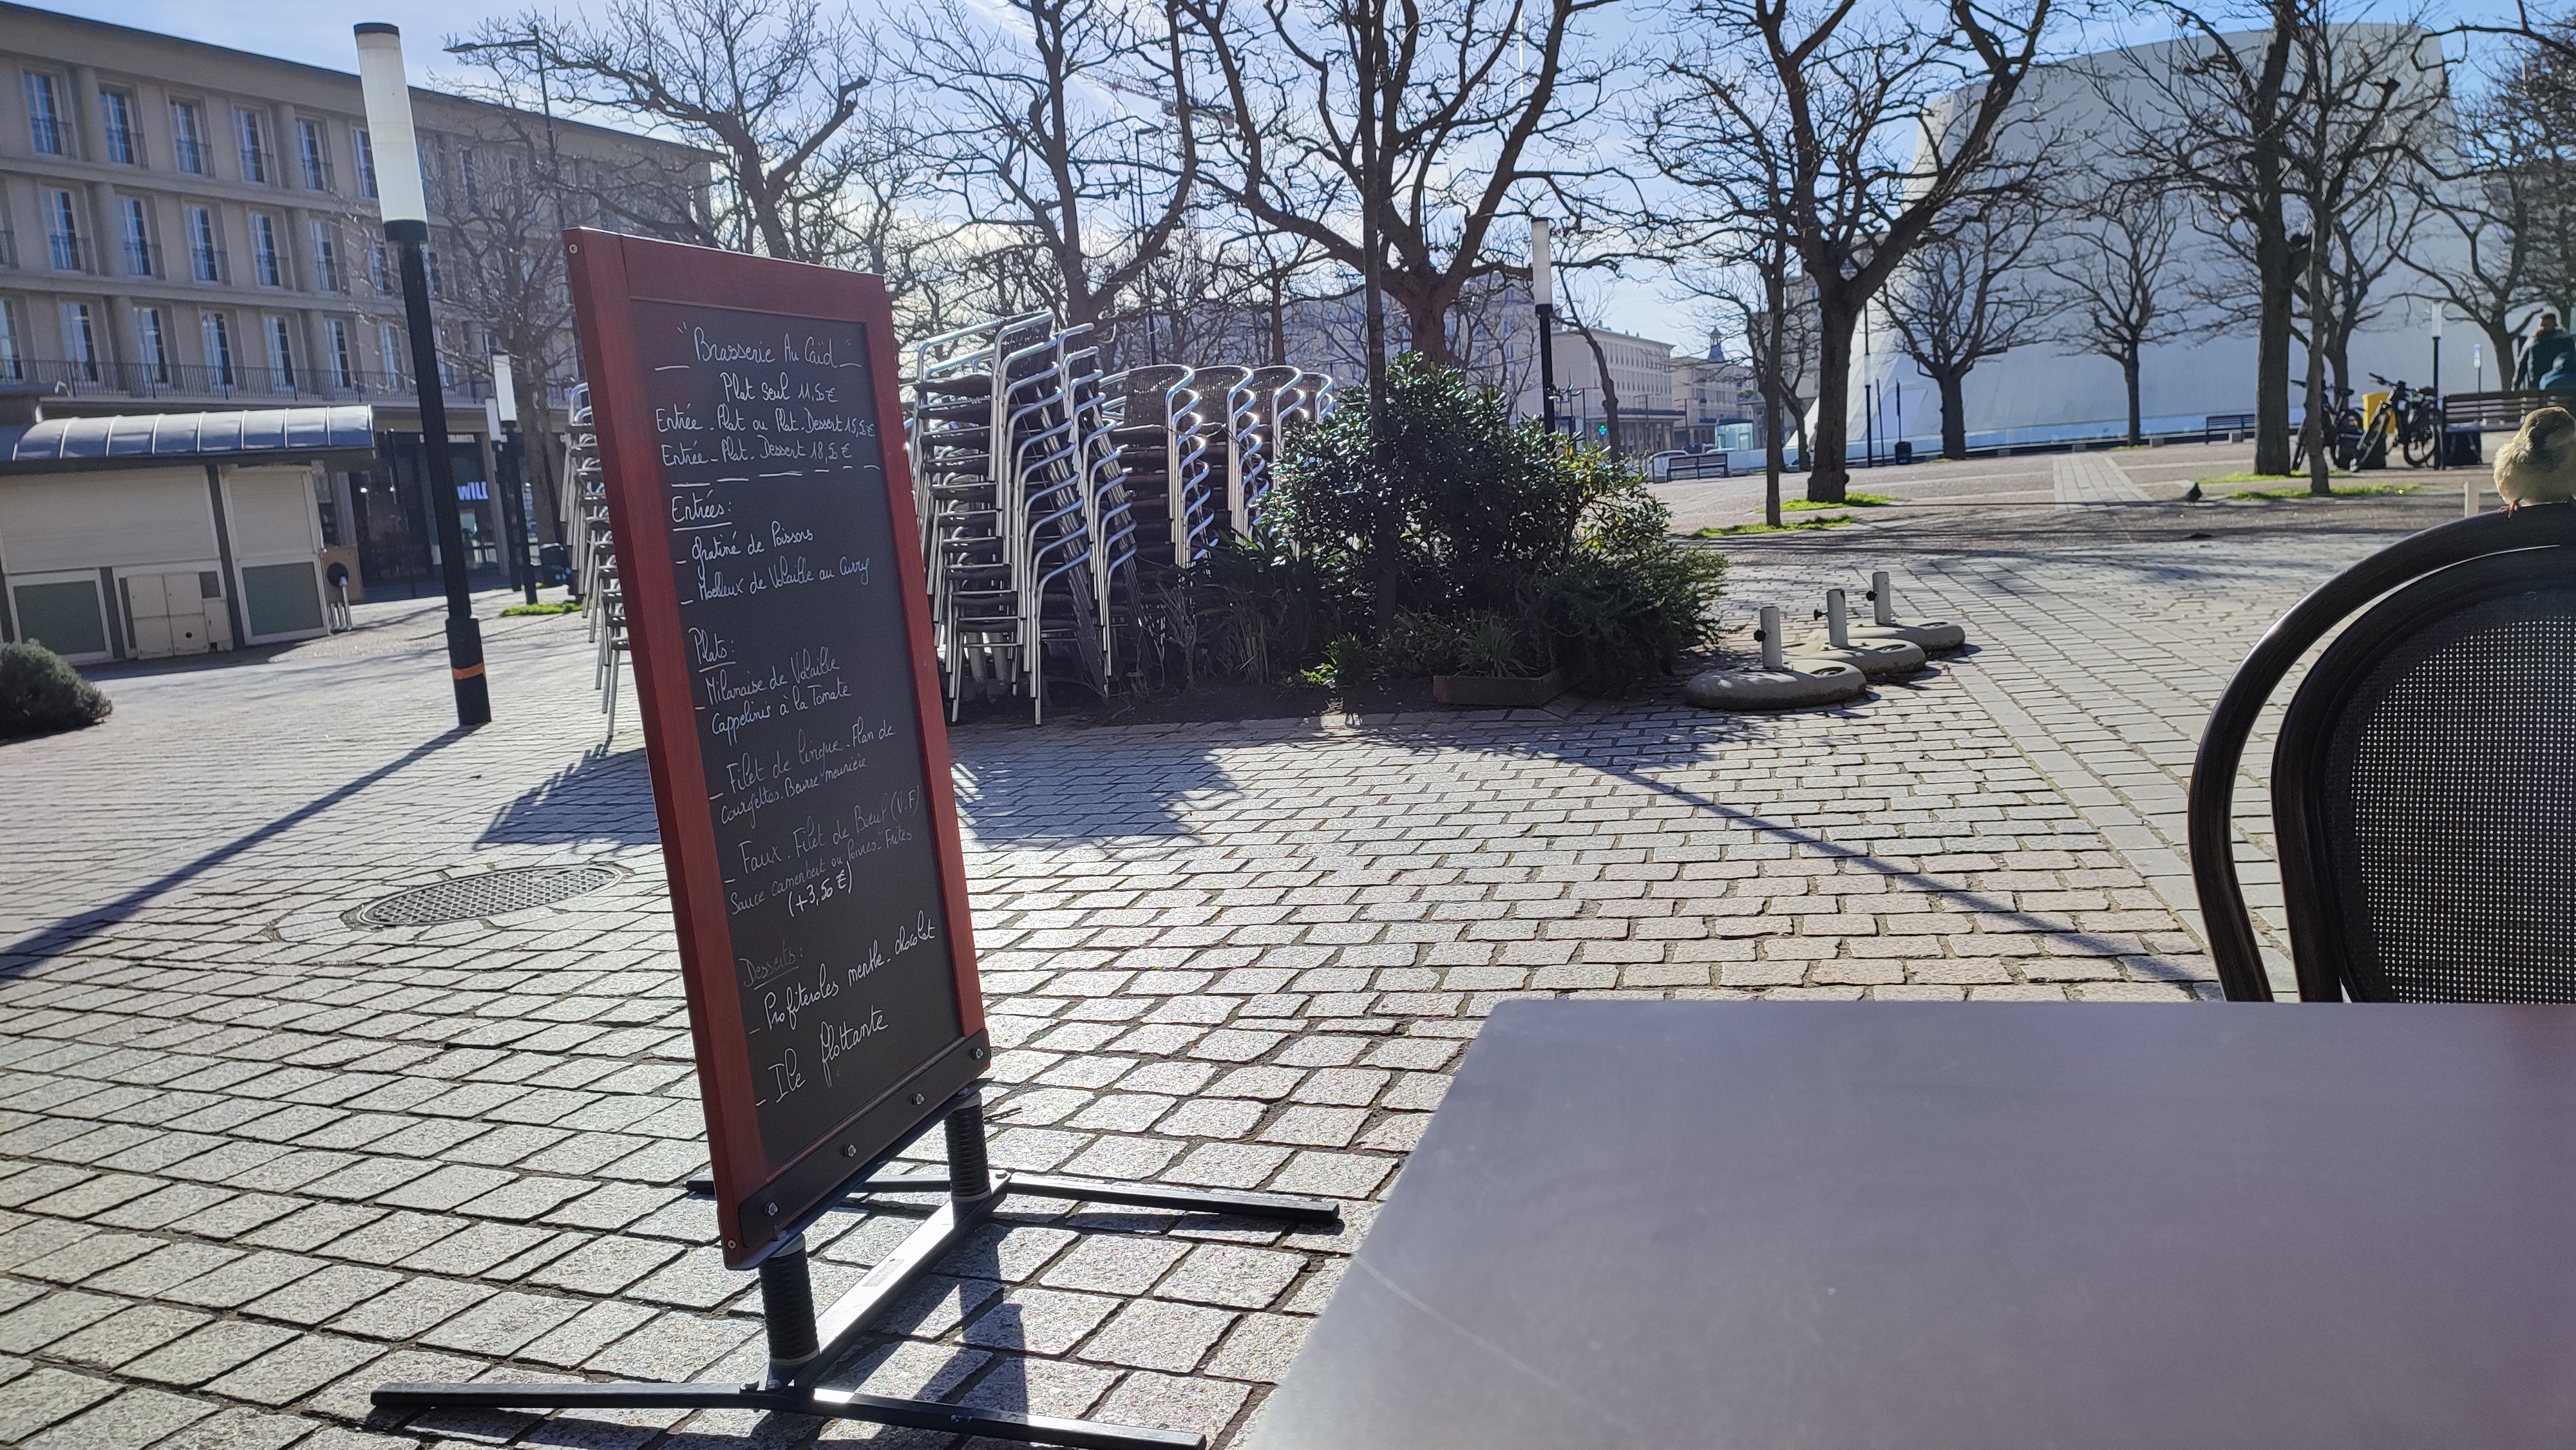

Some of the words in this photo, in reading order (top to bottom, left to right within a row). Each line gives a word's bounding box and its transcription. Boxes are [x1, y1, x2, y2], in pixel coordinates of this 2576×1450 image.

[784, 333, 800, 362] Au
[720, 372, 755, 402] Plat
[656, 403, 703, 432] Entrée
[717, 403, 746, 431] Plat
[753, 419, 768, 431] ou
[775, 407, 797, 433] Plat
[804, 407, 843, 433] Dessert
[661, 440, 708, 466] Entrée
[721, 438, 749, 463] Plat
[757, 435, 806, 458] Dessert
[748, 533, 765, 555] de
[772, 520, 813, 548] Poissons
[698, 571, 744, 601] Moelleux
[750, 571, 767, 594] de
[768, 555, 814, 588] Volaille
[819, 568, 835, 580] au
[705, 669, 767, 705] Milanaise
[770, 665, 788, 690] de
[790, 646, 840, 684] Volaille
[780, 694, 790, 716] à
[793, 686, 809, 711] la
[807, 676, 852, 706] Tomate
[726, 753, 766, 794] Filet
[773, 749, 792, 778] de
[852, 716, 875, 747] Flan
[878, 719, 896, 740] de
[784, 777, 820, 798] Beurre
[738, 840, 782, 874] Faux
[793, 816, 825, 858] Filet
[833, 819, 850, 845] de
[730, 891, 766, 914] Sauce
[831, 856, 844, 867] ou
[885, 825, 912, 849] Frites
[764, 963, 839, 1031] Profiteroles
[848, 939, 884, 987] menthe
[768, 1048, 806, 1103] Ile
[820, 1005, 888, 1088] flottante
